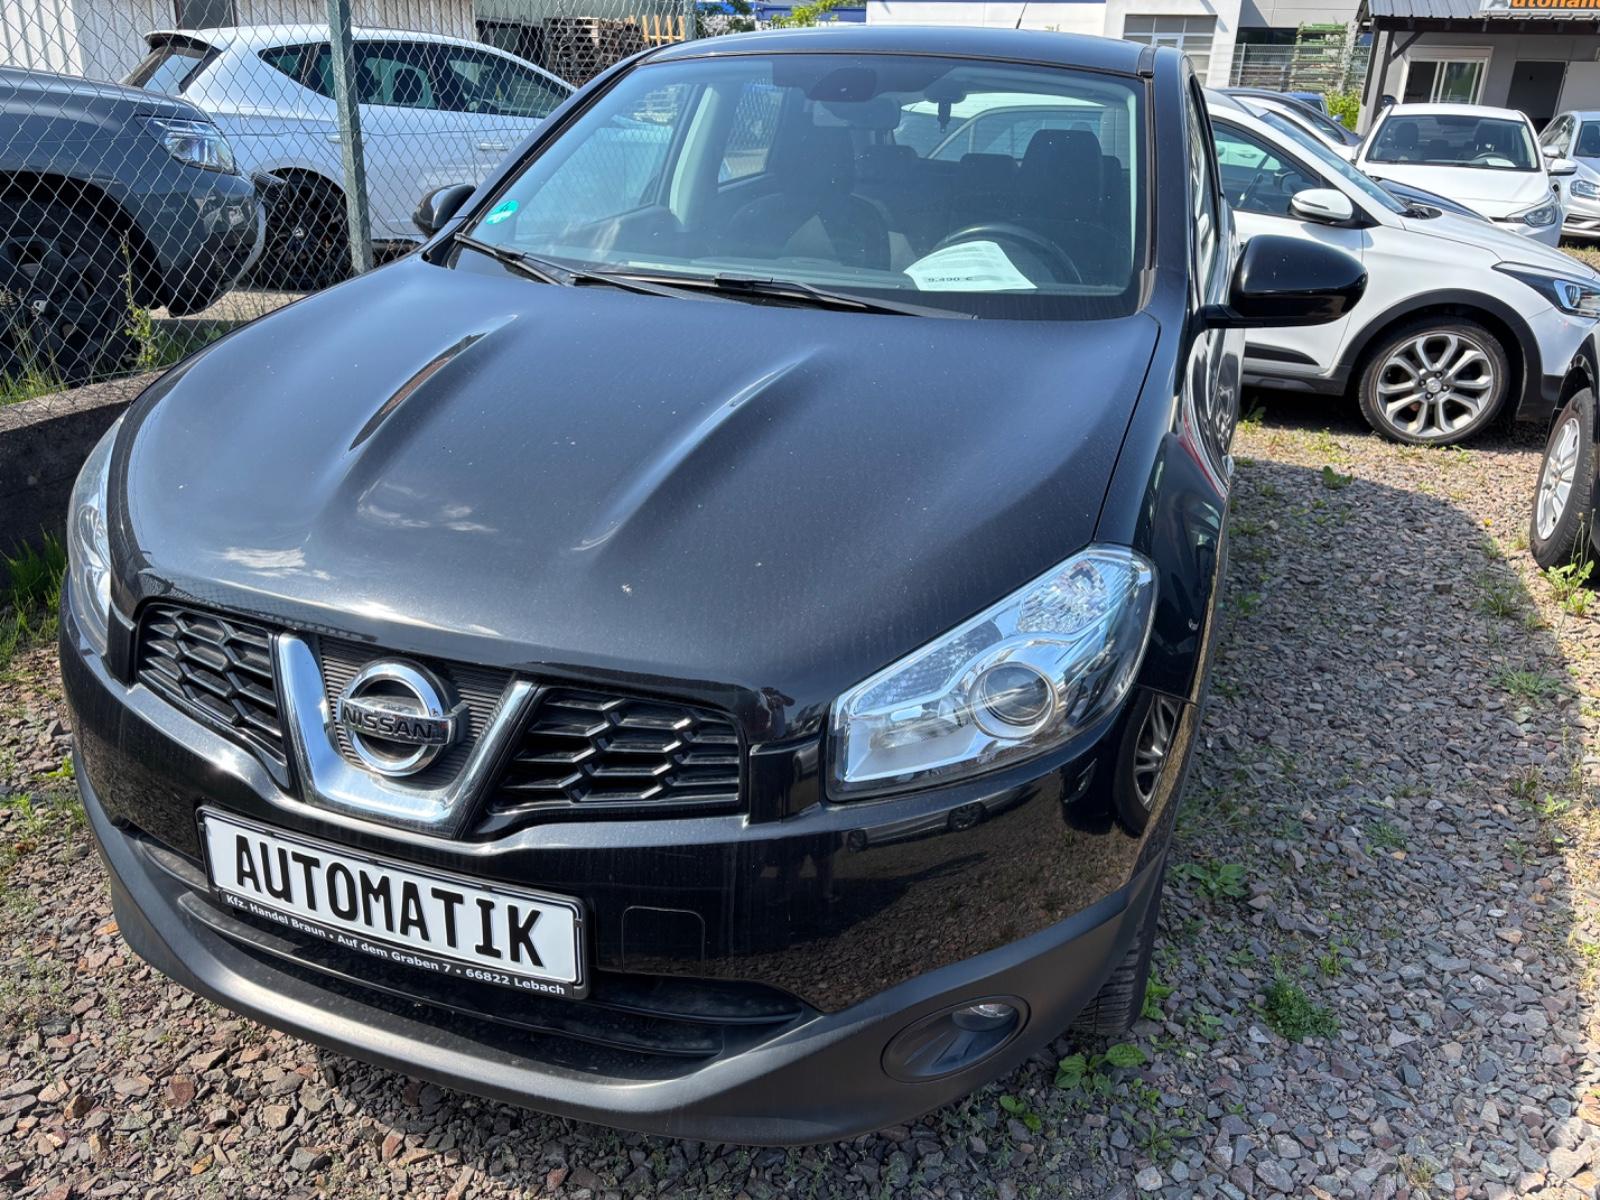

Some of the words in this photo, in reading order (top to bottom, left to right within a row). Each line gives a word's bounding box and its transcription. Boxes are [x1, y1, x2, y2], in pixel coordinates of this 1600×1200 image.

[343, 706, 432, 739] NISSAN
[226, 894, 248, 909] Kfz.
[250, 903, 289, 925] Handel
[291, 918, 326, 937] Braun
[337, 935, 358, 949] Auf
[361, 943, 388, 957] dem
[391, 951, 439, 970] Graben
[442, 963, 451, 973] 7
[465, 968, 511, 985] 66822
[514, 978, 565, 995] Lebach
[235, 834, 544, 967] AUTOMATIK
